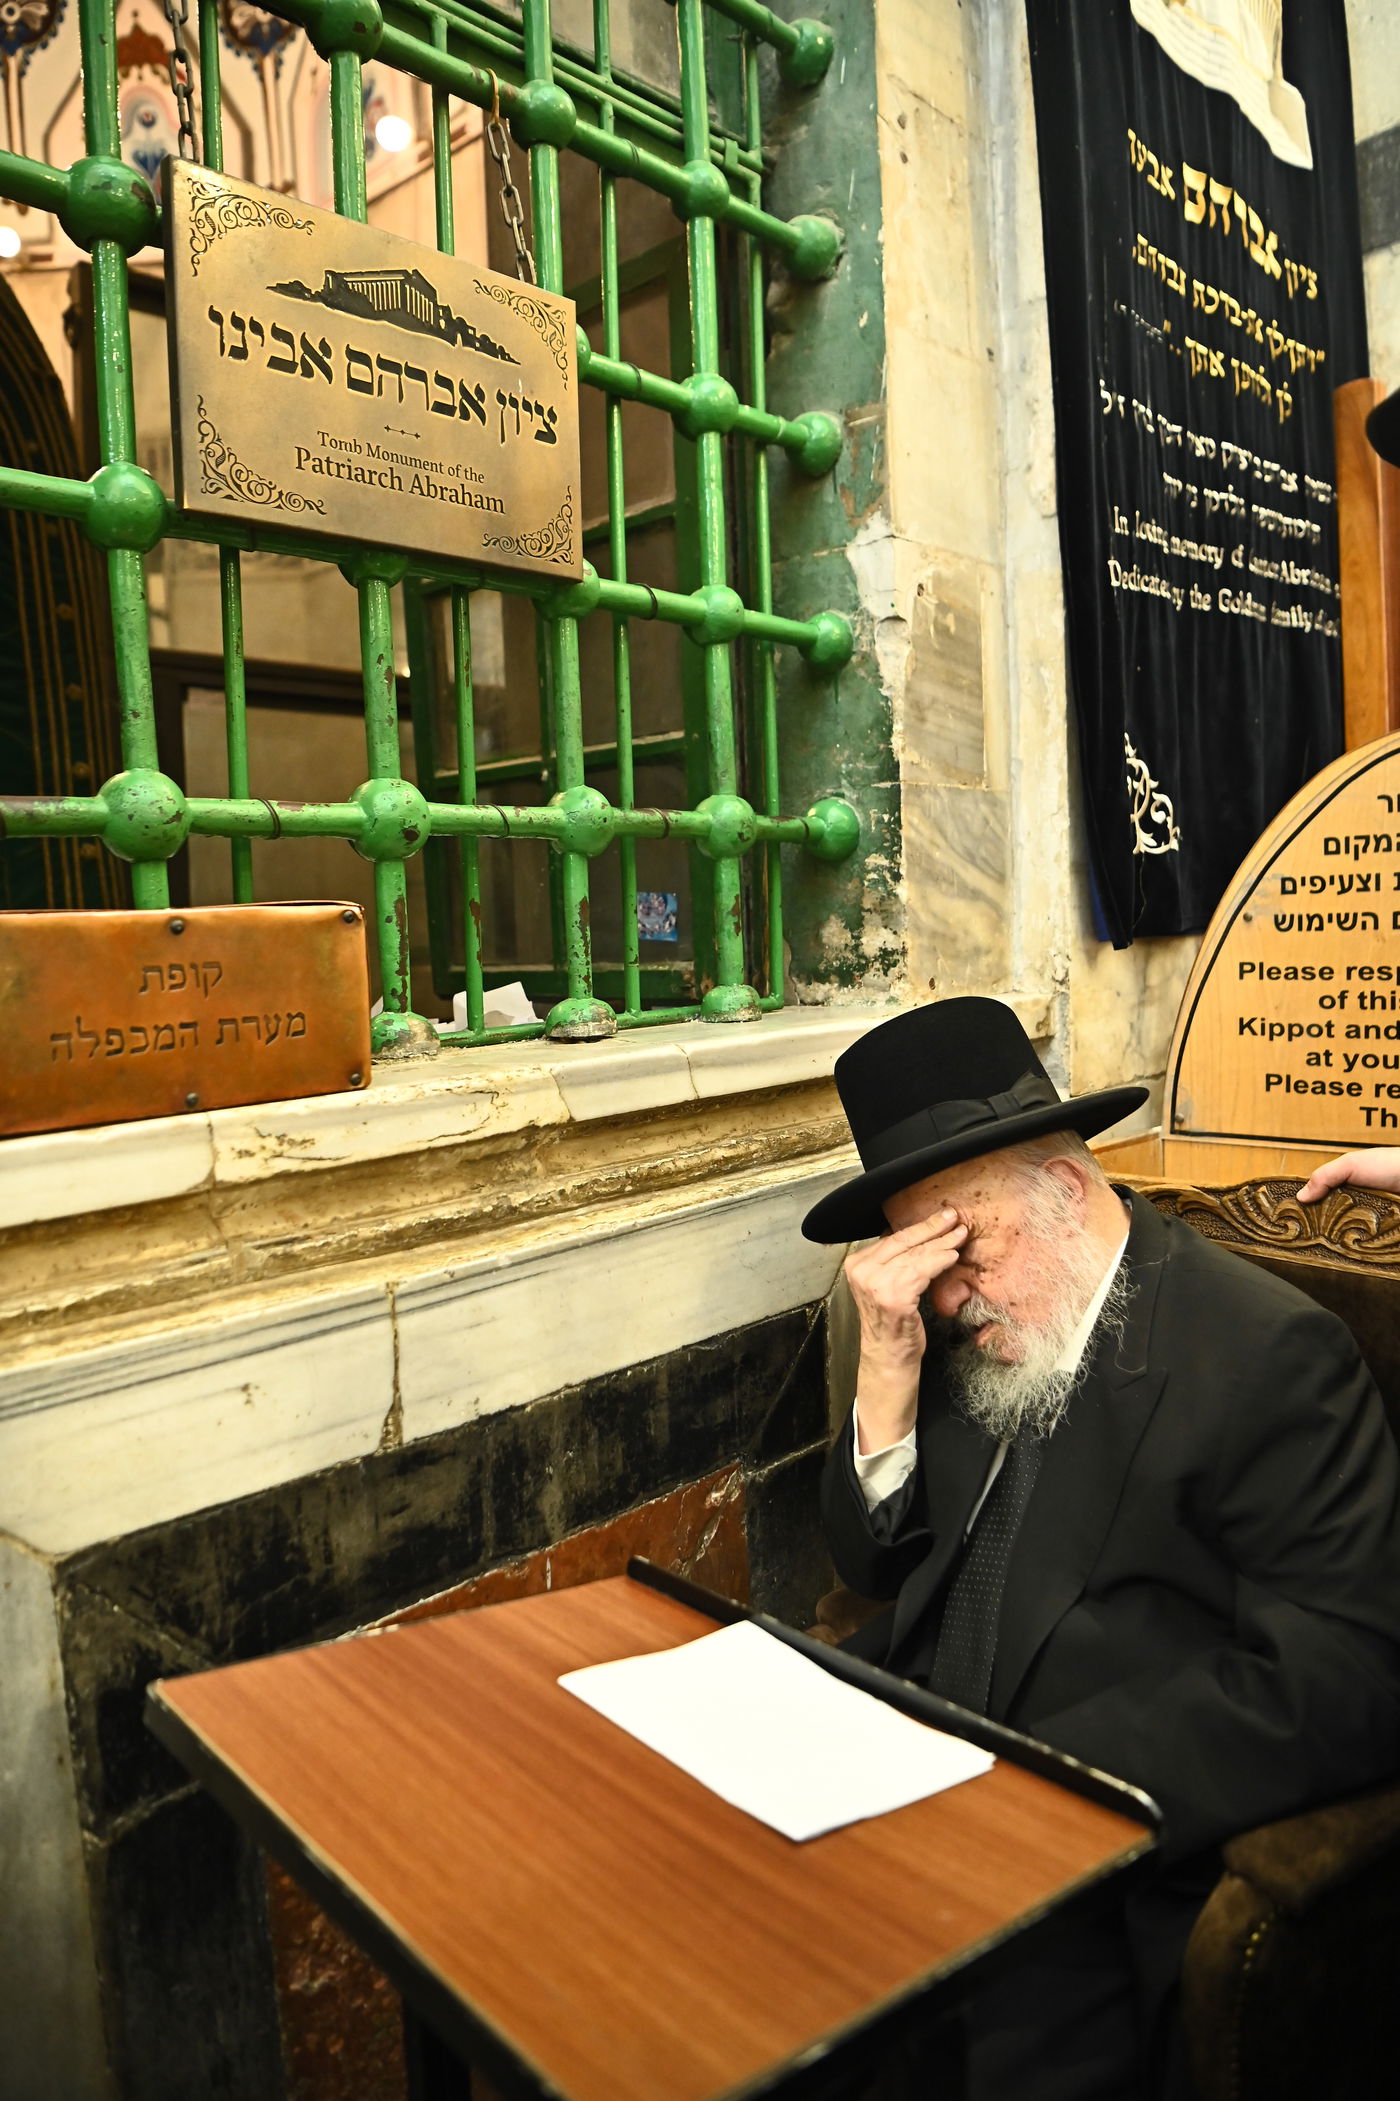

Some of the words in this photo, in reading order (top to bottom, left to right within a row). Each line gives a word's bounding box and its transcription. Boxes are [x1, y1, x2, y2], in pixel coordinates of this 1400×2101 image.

[1182, 161, 1282, 280] אברהם
[208, 304, 334, 385] אבינו
[344, 343, 487, 426] אברהם
[495, 389, 559, 446] ציון
[317, 430, 363, 455] Tomb
[366, 443, 445, 475] Monument
[447, 464, 462, 479] of
[464, 467, 485, 484] the
[295, 446, 404, 492] Patriarch
[409, 473, 506, 515] Abraham
[1113, 505, 1130, 536] In
[1108, 559, 1171, 600] Dedicate
[1190, 582, 1212, 612] the
[1280, 872, 1381, 896] וצעיפים
[1274, 911, 1380, 933] השימוש
[138, 961, 224, 998] קופת
[1239, 961, 1335, 981] Please
[1318, 989, 1349, 1010] of
[1357, 990, 1400, 1011] thi
[50, 1015, 199, 1063] המכפלה
[215, 1011, 307, 1046] מערת
[1239, 1017, 1335, 1042] Kippot
[1345, 1020, 1400, 1040] and
[1305, 1049, 1333, 1067] at
[1343, 1053, 1400, 1073] you
[1265, 1073, 1363, 1097] Please
[1359, 1106, 1398, 1128] Th
